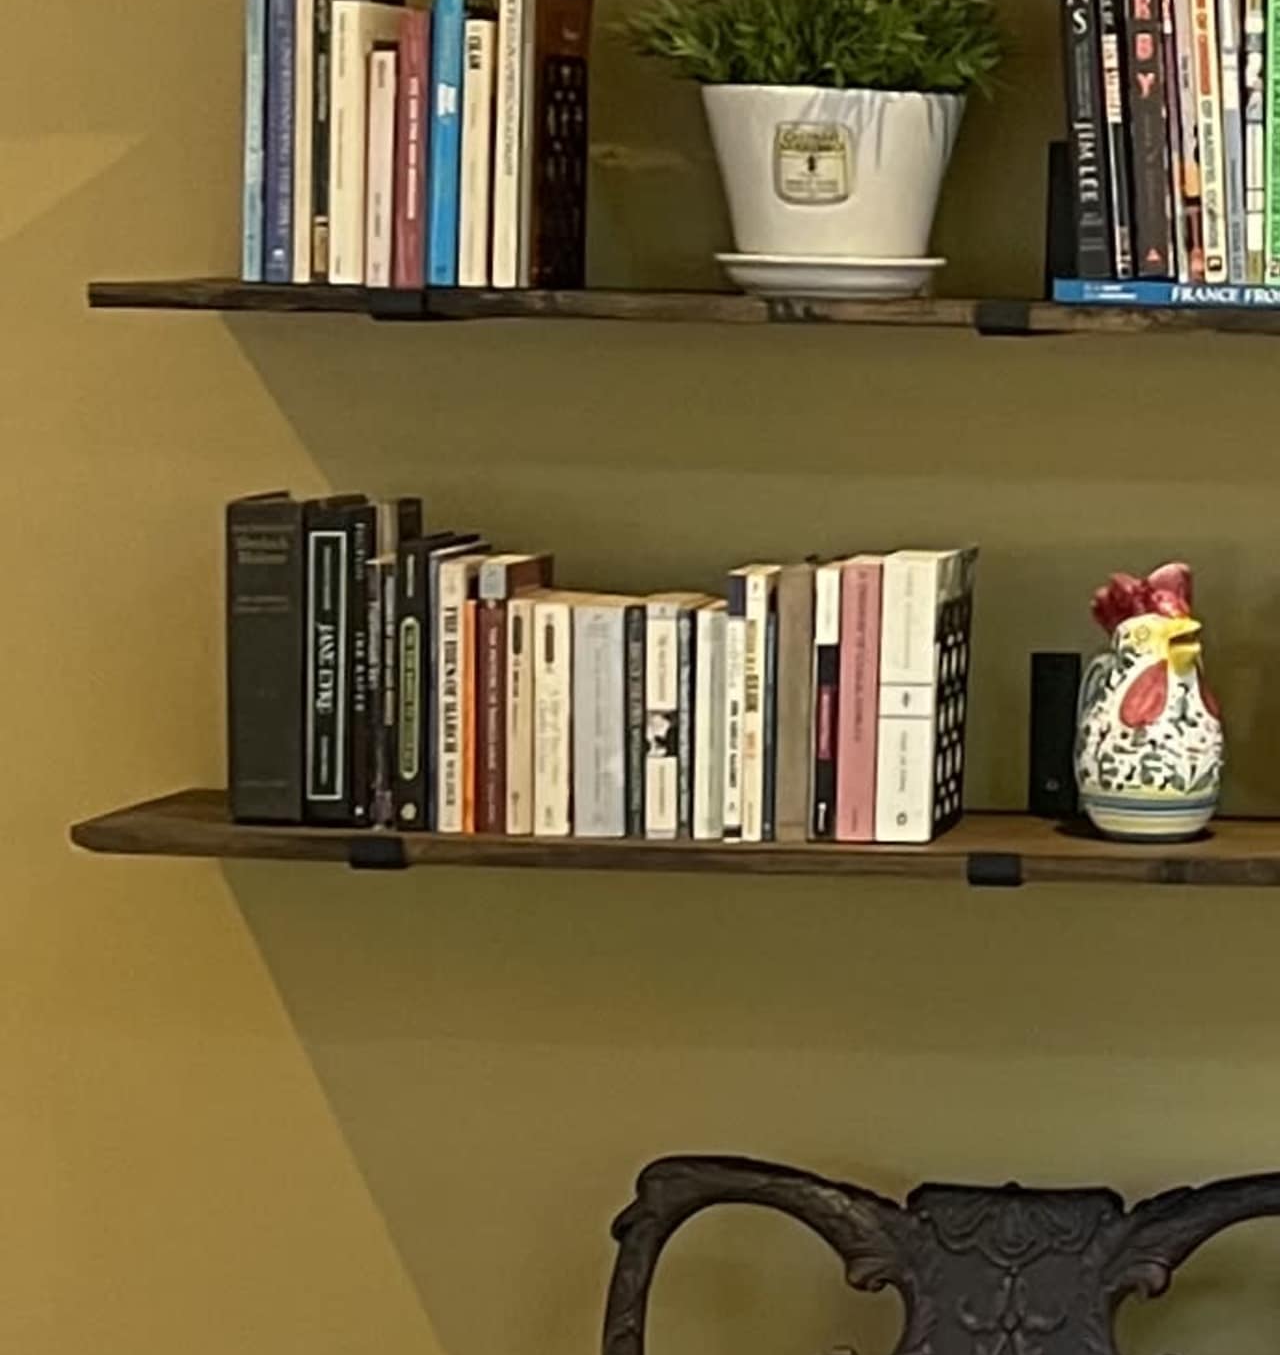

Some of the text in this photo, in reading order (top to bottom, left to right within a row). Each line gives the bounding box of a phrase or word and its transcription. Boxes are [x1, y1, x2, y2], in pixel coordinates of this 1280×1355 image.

[1171, 286, 1239, 304] FRANCE
[443, 605, 458, 633] THE
[315, 622, 337, 714] JANE EYRE
[443, 701, 458, 753] MARCH
